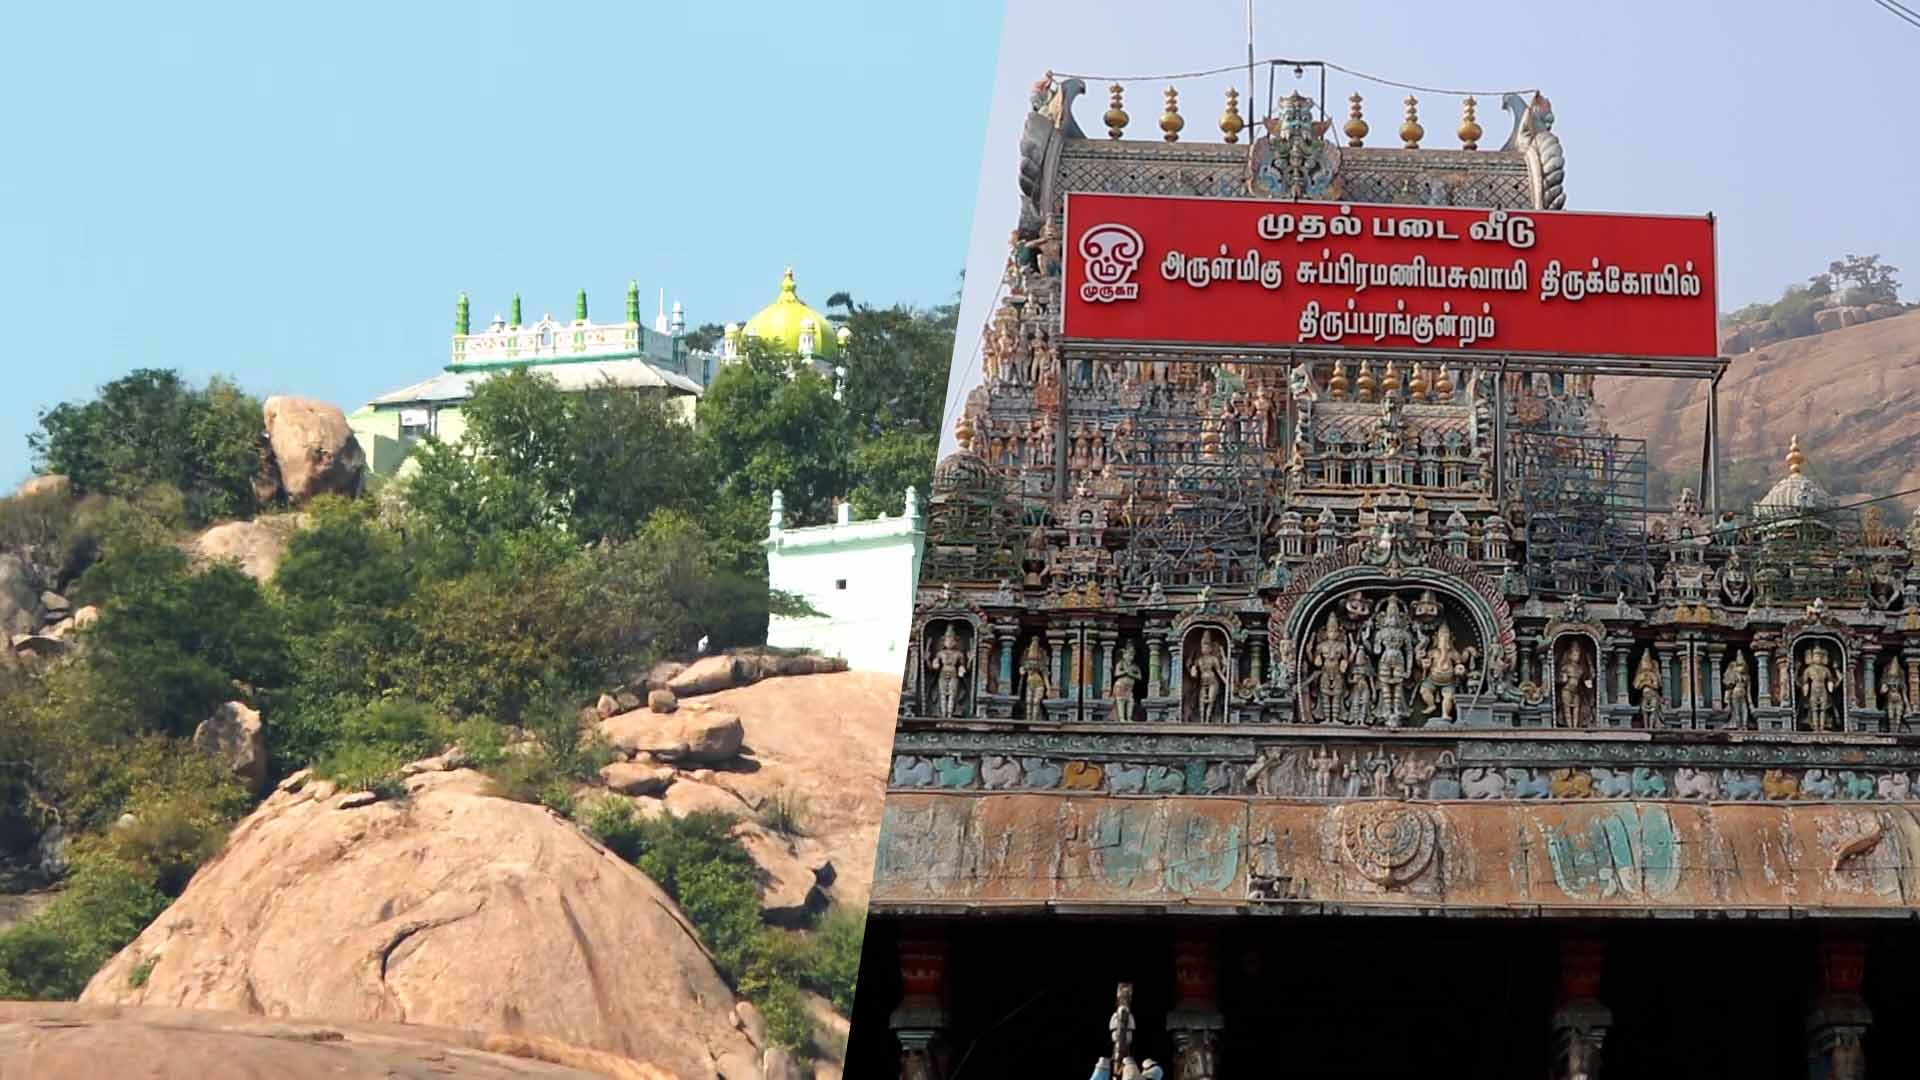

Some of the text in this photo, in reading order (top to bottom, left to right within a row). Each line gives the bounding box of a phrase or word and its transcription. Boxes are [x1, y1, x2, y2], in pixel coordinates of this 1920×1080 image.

[1258, 205, 1536, 248] முதல் படை வீடு
[1082, 284, 1137, 300] முருகா
[1161, 244, 1701, 300] அருள்மிகு சுப்பிரமணியசுவாமி திருக்கோயில்
[1298, 299, 1495, 347] திருப்பரங்குன்றம்
